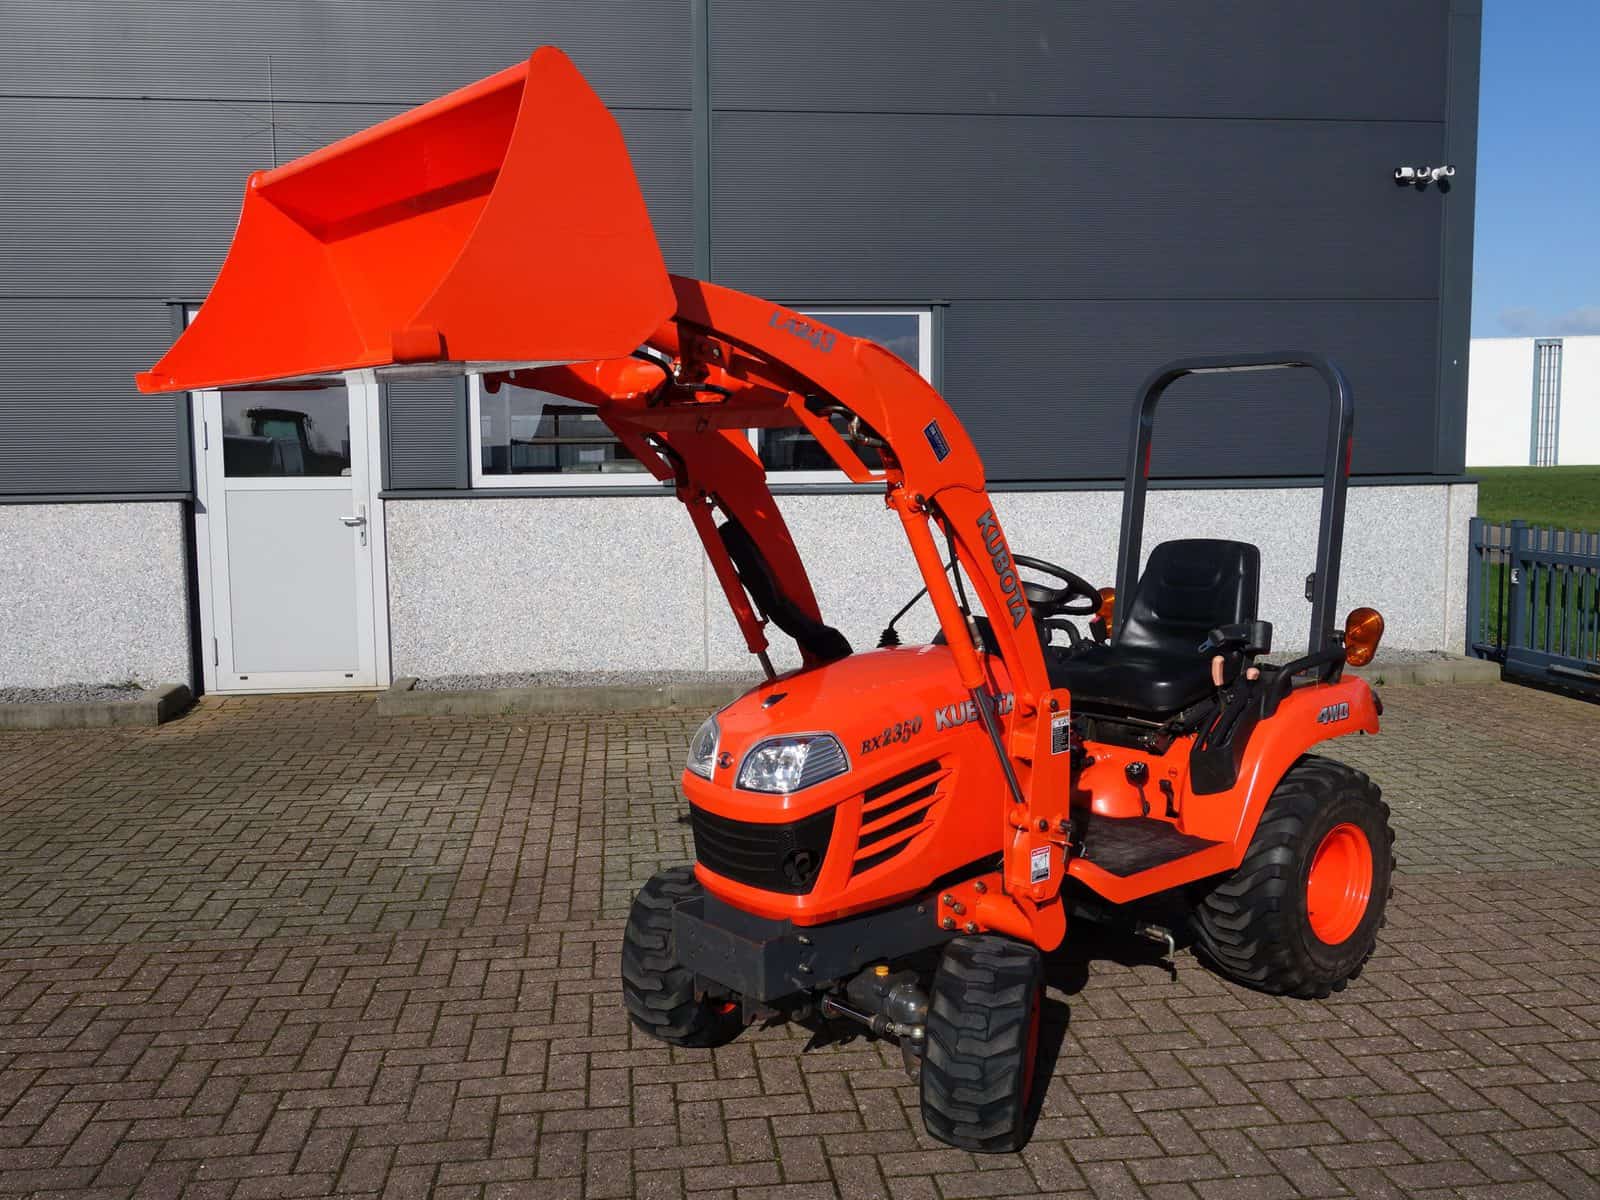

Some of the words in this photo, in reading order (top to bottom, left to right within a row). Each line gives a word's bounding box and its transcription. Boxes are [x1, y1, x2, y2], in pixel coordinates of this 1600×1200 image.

[976, 508, 1027, 629] KUBOTA
[935, 692, 1014, 732] KUBTA
[1316, 702, 1349, 724] 4WD
[861, 716, 922, 755] BX2350
